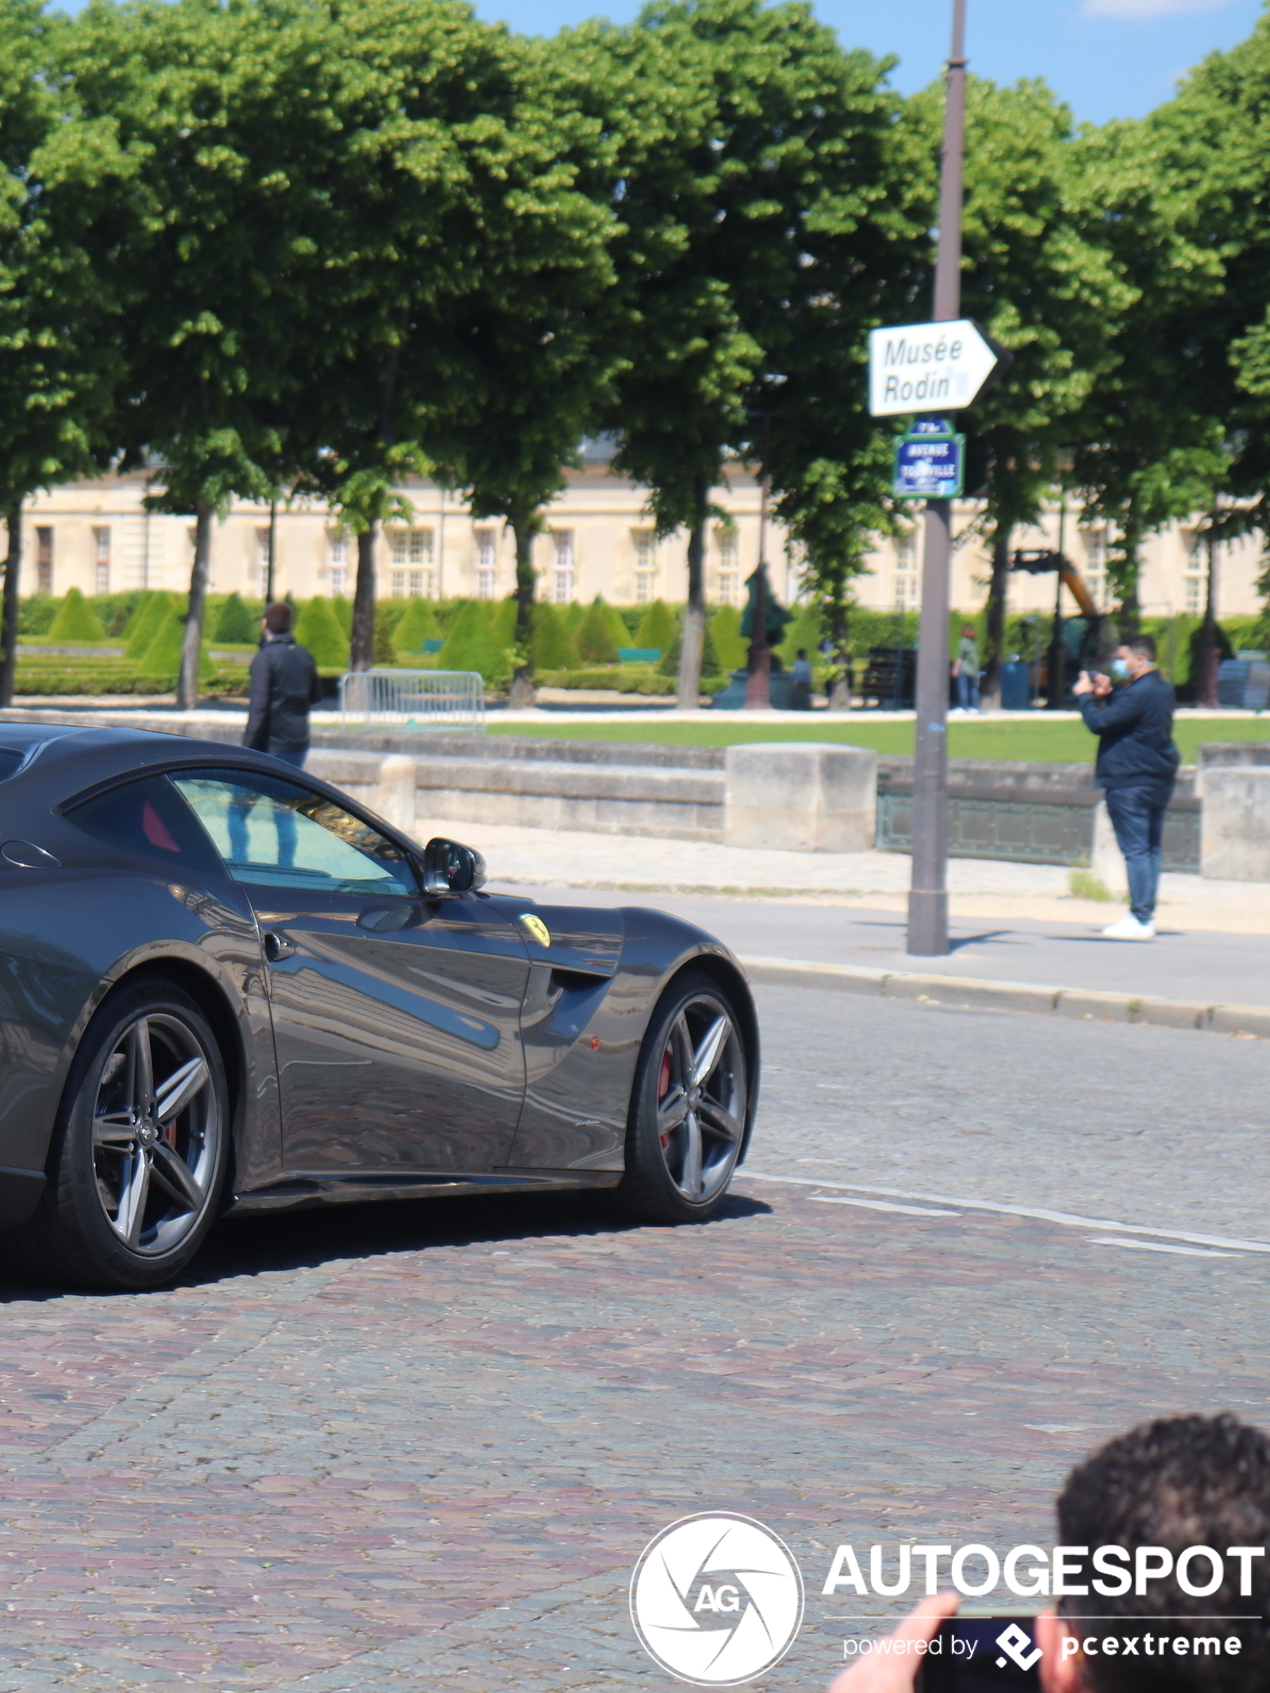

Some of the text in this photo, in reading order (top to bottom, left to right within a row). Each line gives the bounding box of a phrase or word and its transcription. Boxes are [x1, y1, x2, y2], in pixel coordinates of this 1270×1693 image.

[883, 334, 963, 367] Musée
[884, 371, 950, 403] Rodin
[908, 443, 949, 457] AVENUE
